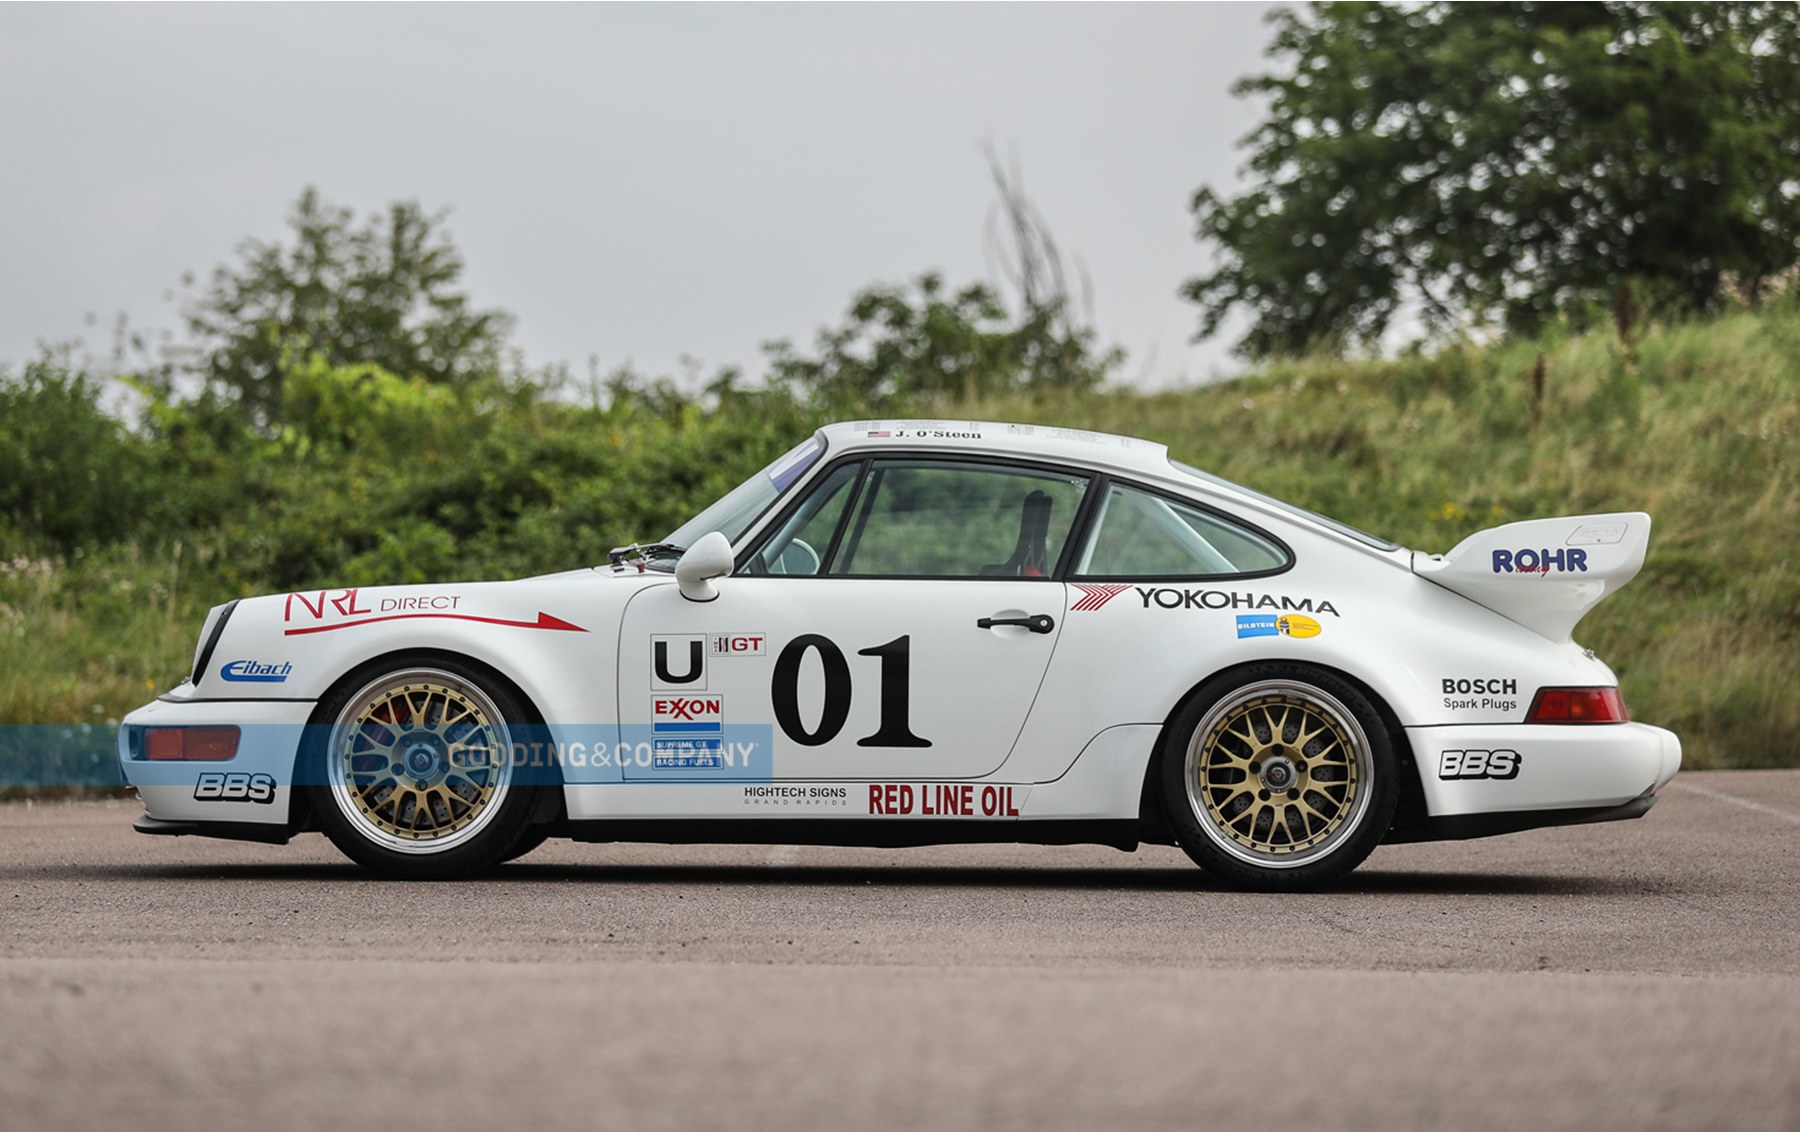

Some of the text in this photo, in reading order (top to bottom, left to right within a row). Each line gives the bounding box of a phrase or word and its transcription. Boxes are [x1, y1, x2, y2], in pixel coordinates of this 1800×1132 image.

[896, 430, 982, 439] J. O'Steen
[1492, 548, 1588, 574] ROHR
[284, 588, 461, 622] NRL DIRECT
[1135, 587, 1341, 617] YOKOHAMA
[1237, 622, 1276, 630] BILSTEIN
[731, 637, 763, 651] GT
[220, 660, 293, 683] Eibach
[654, 641, 703, 684] U
[771, 634, 933, 748] 01
[1442, 679, 1517, 695] BOSCH
[655, 698, 720, 720] EXXON
[1444, 697, 1517, 711] Spark Plugs
[656, 741, 693, 749] SUPREME
[656, 758, 688, 767] RACING
[1439, 749, 1522, 780] BBS
[193, 772, 277, 804] BBS
[744, 787, 847, 798] HIGHTECH SIGNS
[869, 784, 1019, 817] RED LINE OIL
